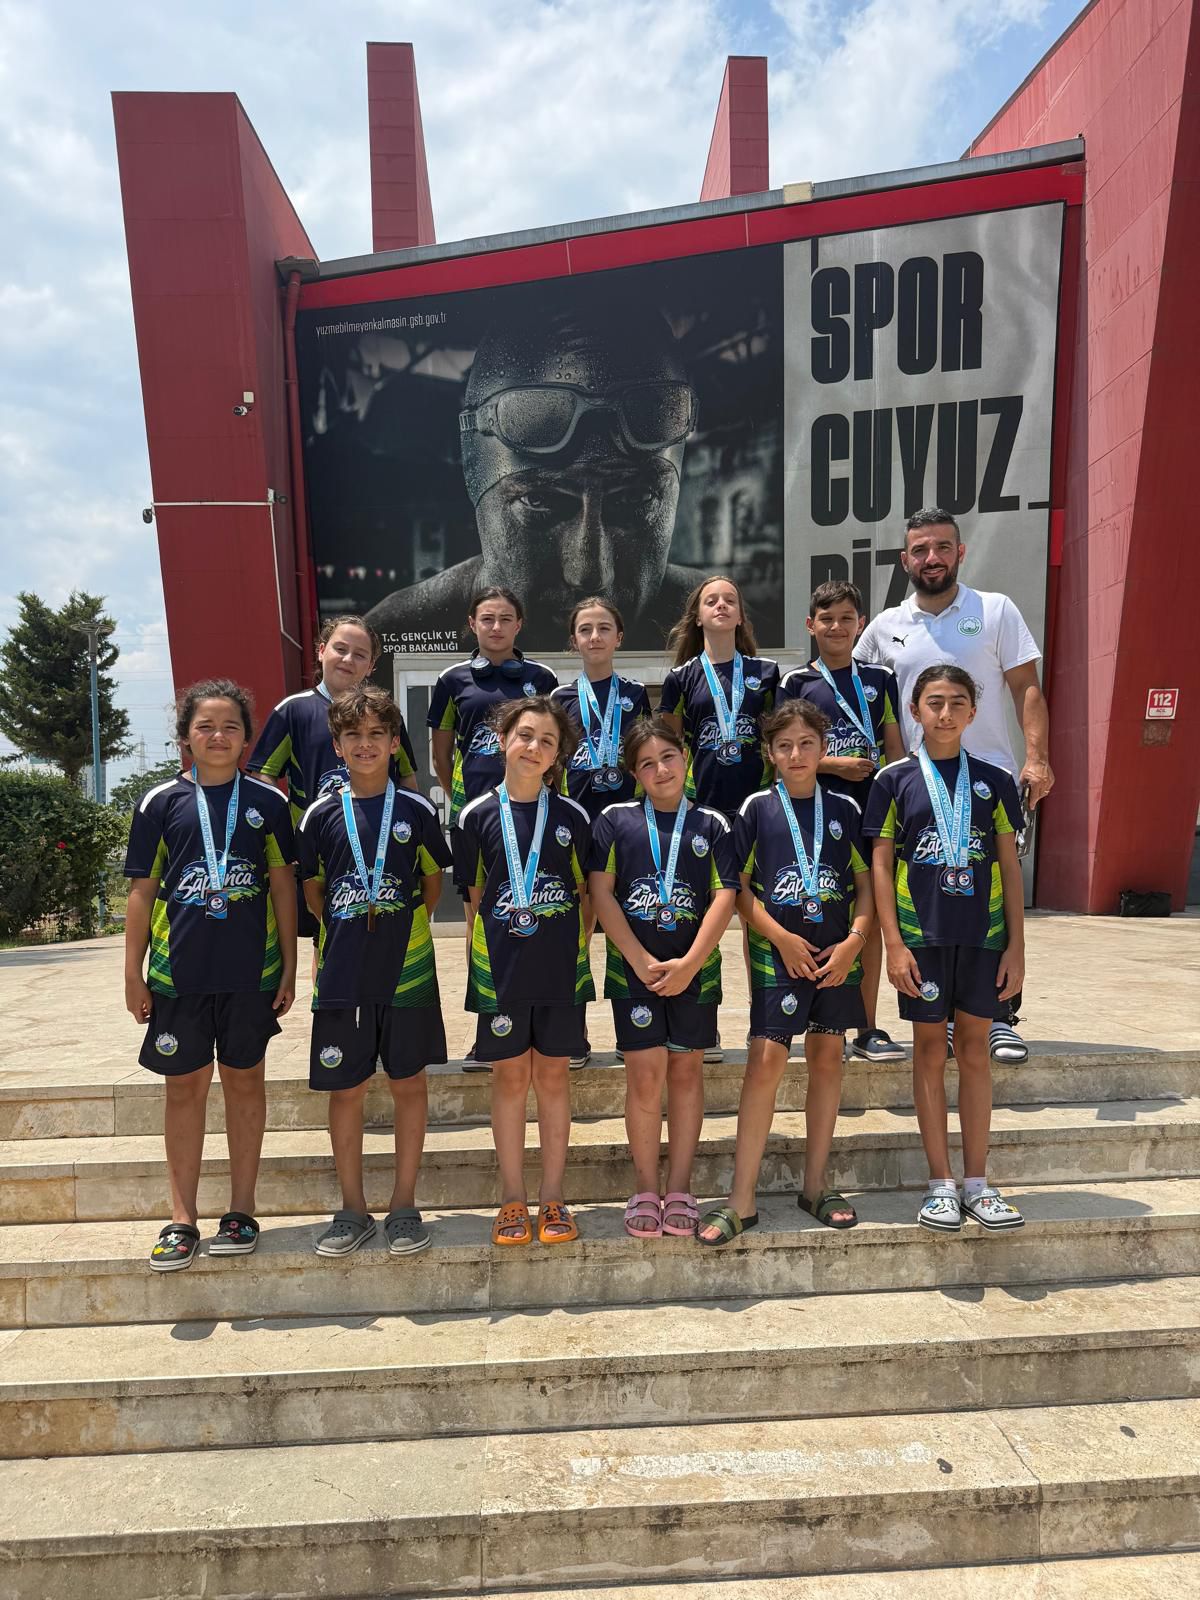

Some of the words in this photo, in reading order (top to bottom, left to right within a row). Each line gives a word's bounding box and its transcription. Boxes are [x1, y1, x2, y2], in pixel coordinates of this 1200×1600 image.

[811, 251, 984, 384] SPOR
[811, 395, 1023, 526] CUYUZ
[382, 633, 398, 642] T.C.
[401, 630, 442, 643] GENÇLİK
[445, 631, 457, 639] VE
[383, 644, 407, 653] SPOR
[410, 640, 458, 652] BAKANLIĞI
[1153, 693, 1172, 706] 112
